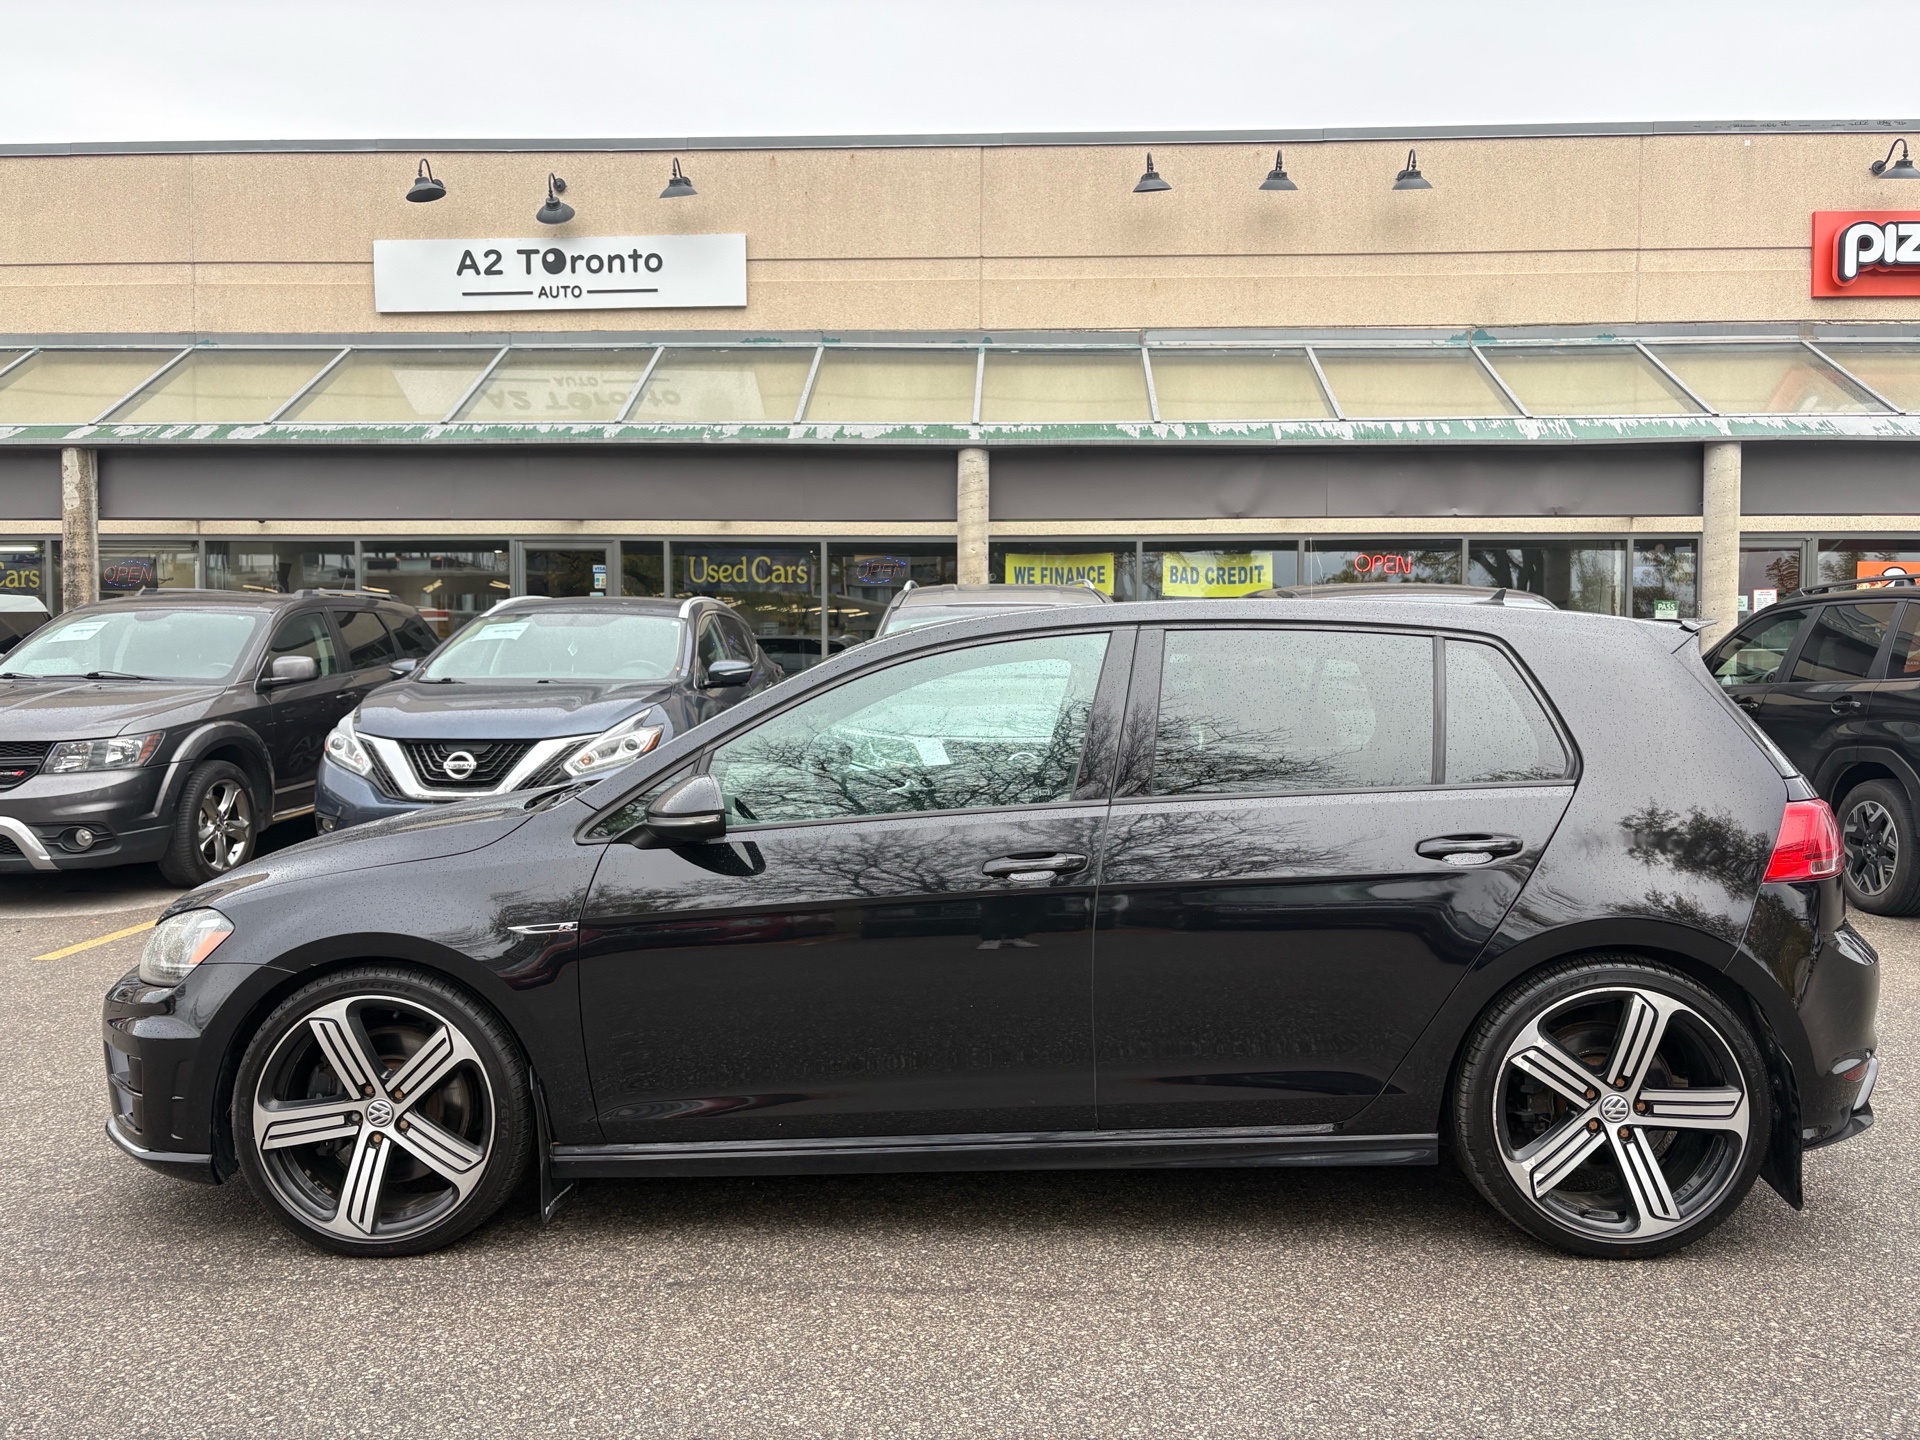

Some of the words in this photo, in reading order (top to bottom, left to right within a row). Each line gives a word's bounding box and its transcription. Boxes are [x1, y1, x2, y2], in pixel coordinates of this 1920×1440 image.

[456, 249, 504, 276] A2
[538, 285, 583, 299] AUTO
[103, 566, 153, 582] OPEN
[689, 556, 748, 583] Used
[751, 556, 808, 583] Cars
[1354, 554, 1412, 574] OPEN
[0, 561, 40, 588] ars
[1014, 566, 1035, 584] WE
[1040, 565, 1105, 585] FINANCE
[1169, 565, 1200, 585] BAD
[1204, 565, 1264, 585] CREDIT
[499, 1096, 510, 1140] ZETA
